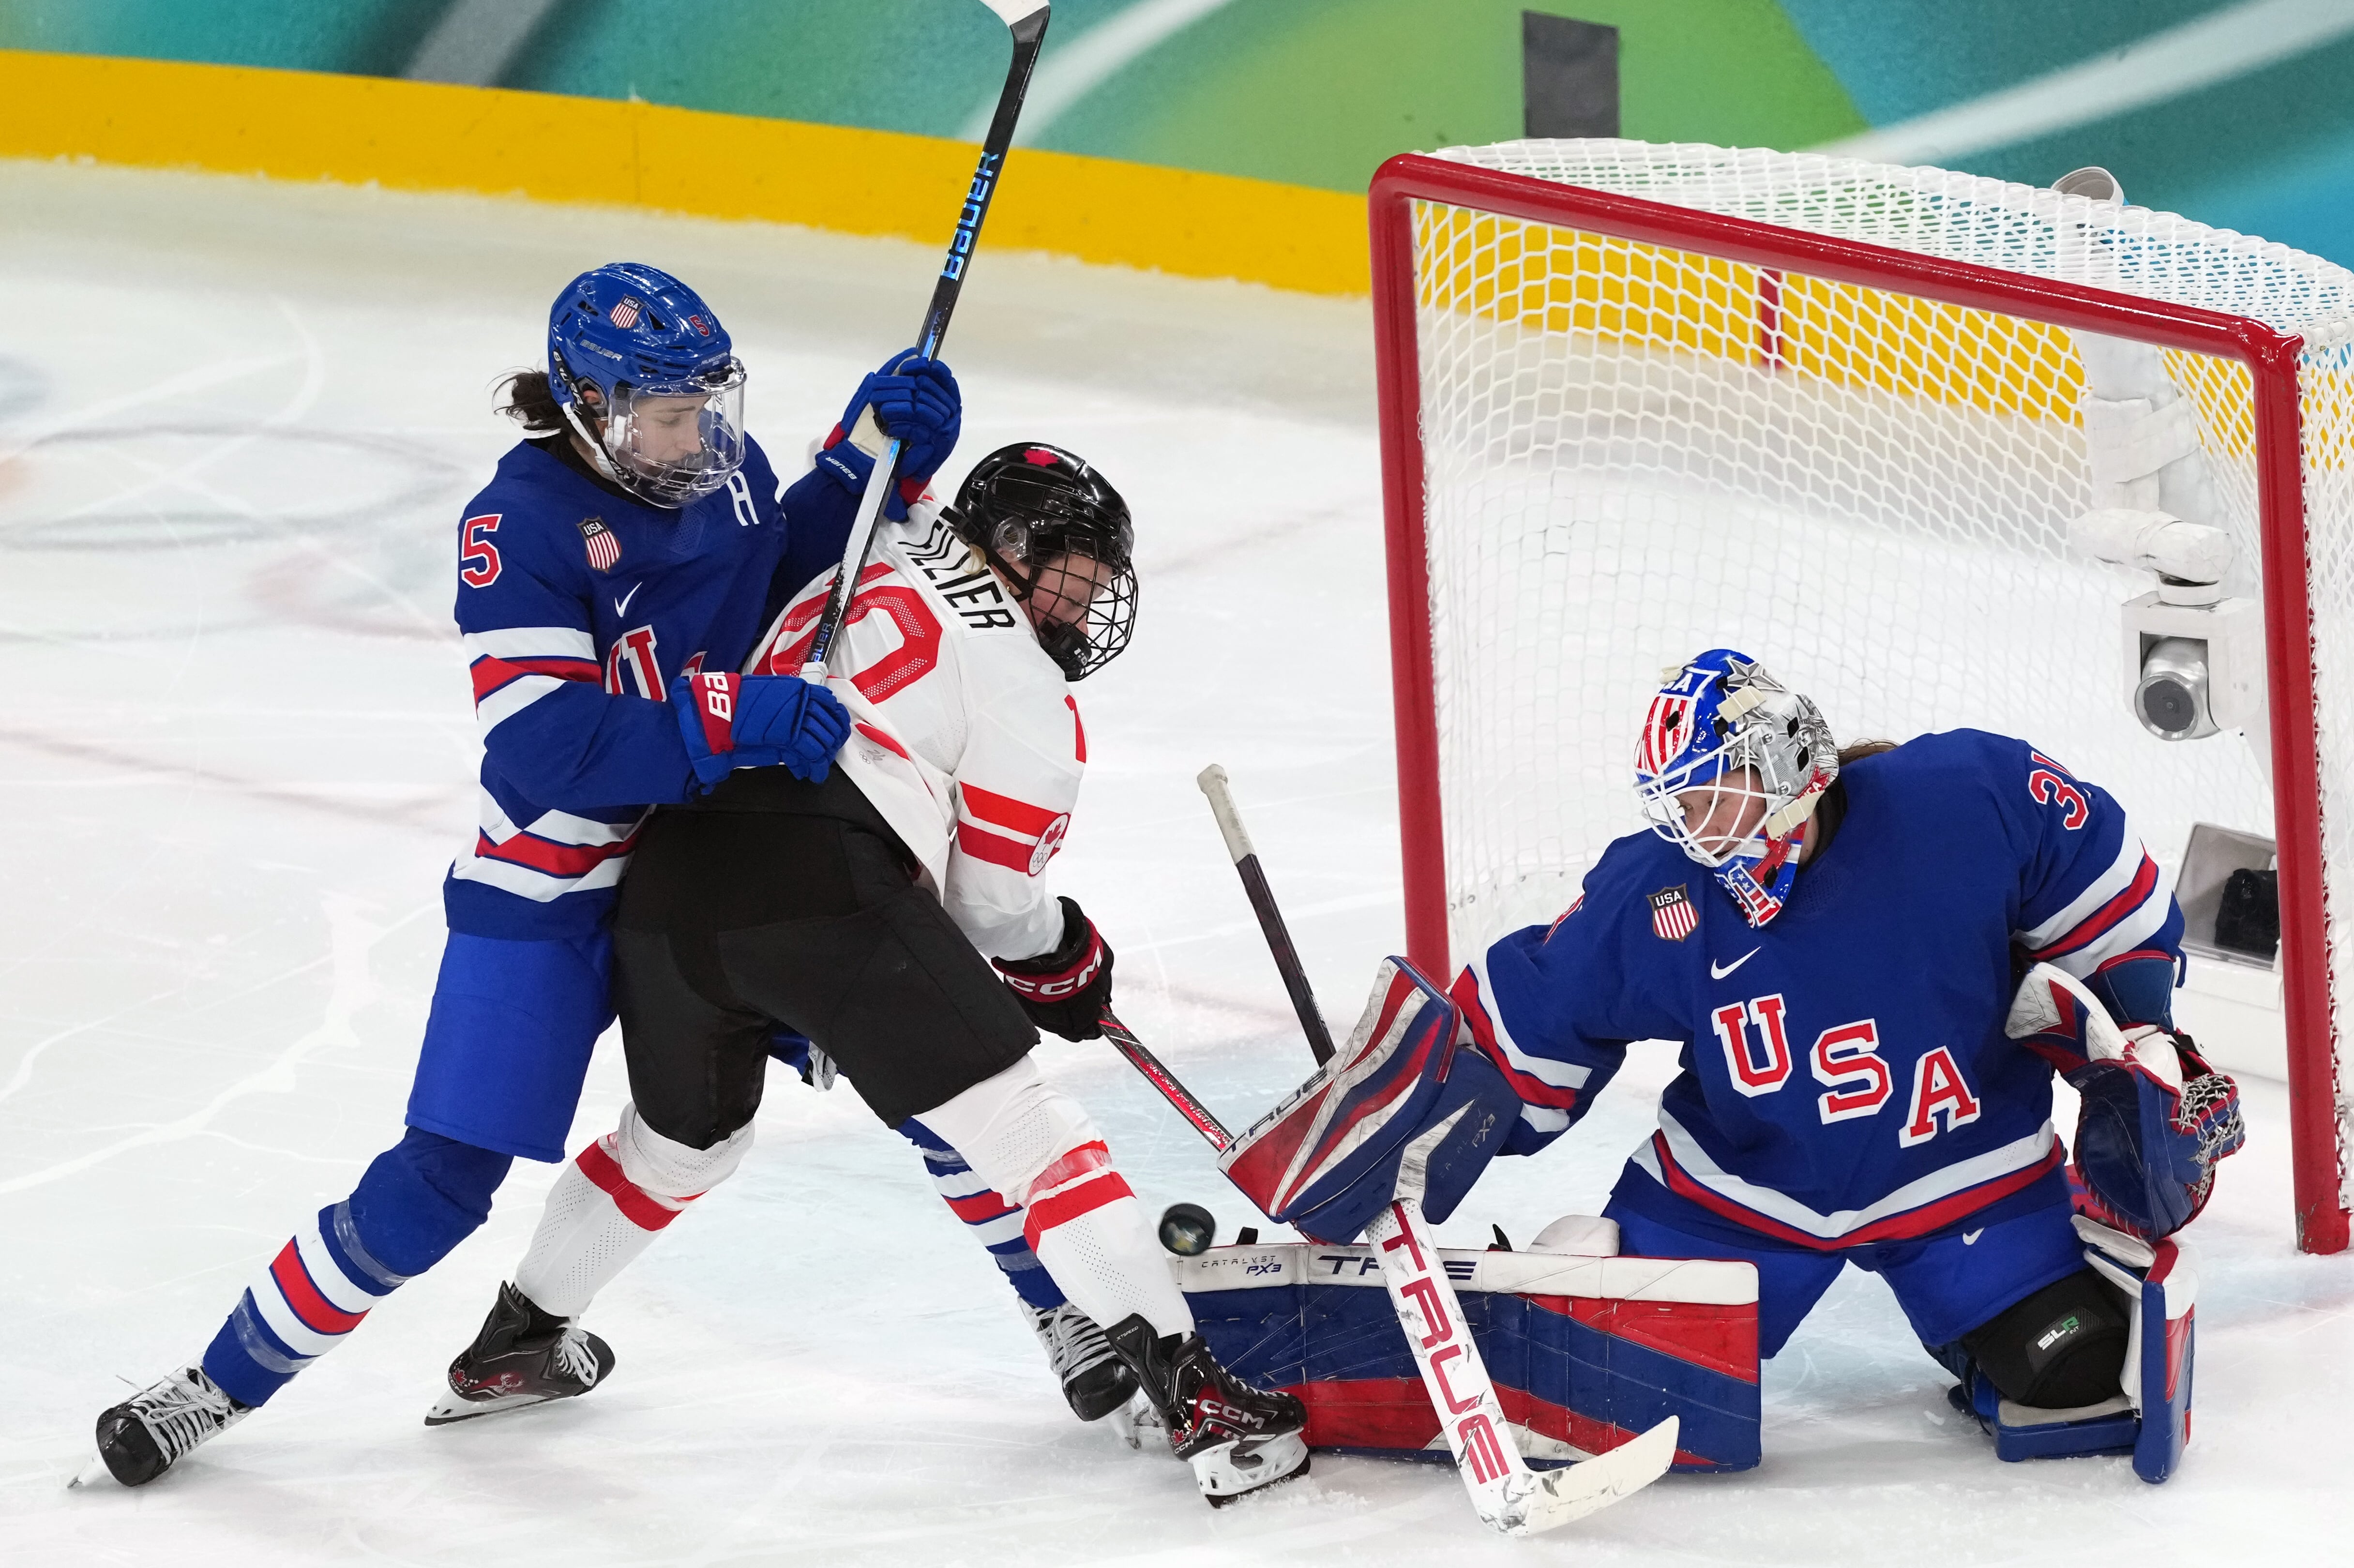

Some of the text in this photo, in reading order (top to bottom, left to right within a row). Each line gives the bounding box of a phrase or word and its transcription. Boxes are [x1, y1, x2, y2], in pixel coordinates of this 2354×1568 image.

[940, 151, 999, 281] BAUER
[623, 297, 639, 310] USA
[688, 315, 709, 337] 5
[580, 339, 623, 362] BAUER
[825, 456, 858, 480] BAUER
[725, 469, 760, 527] A
[583, 521, 604, 536] USA
[461, 513, 502, 589] 5
[1655, 890, 1682, 906] USA
[1006, 945, 1102, 995] CCM
[1711, 993, 1981, 1149] USA
[1201, 1255, 1277, 1268] CATALYST
[1246, 1262, 1282, 1276] PX3
[1382, 1199, 1510, 1485] TRUE
[2037, 1316, 2080, 1351] SLR
[1199, 1399, 1265, 1430] CCM
[1174, 1438, 1194, 1455] CCM
